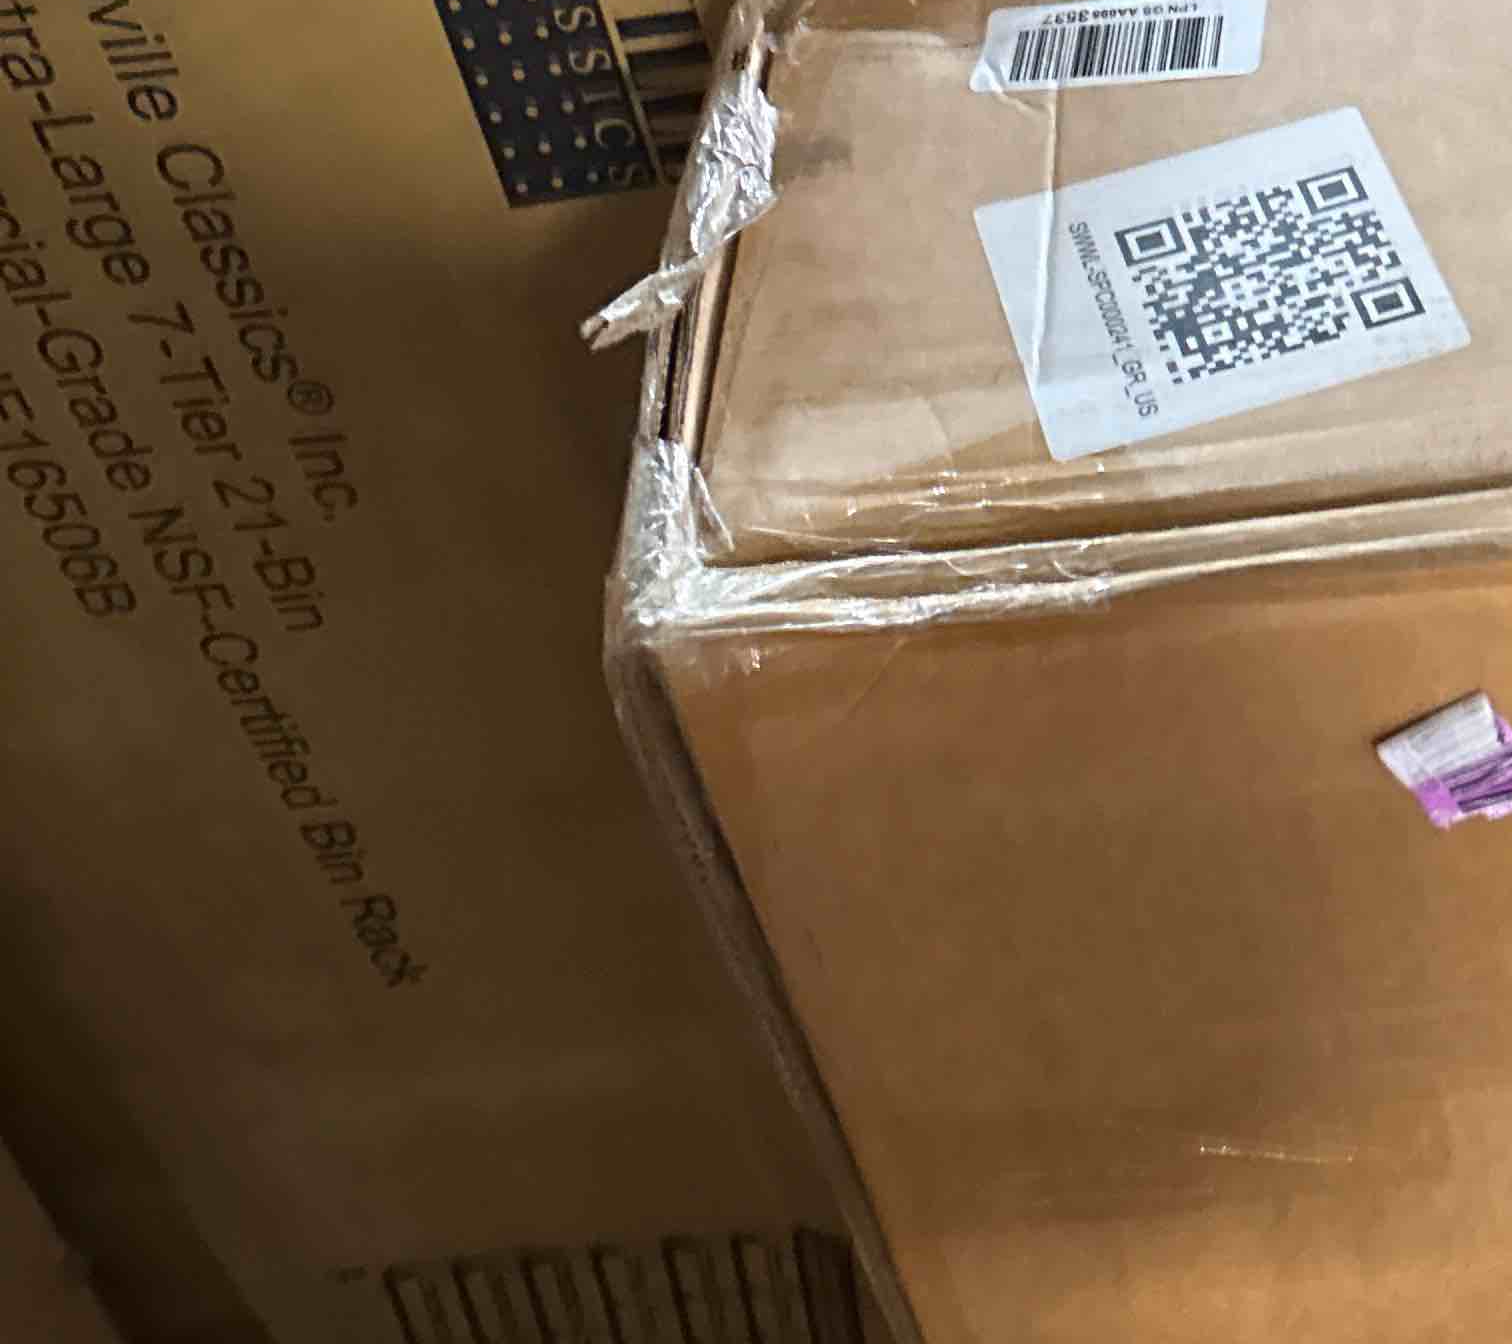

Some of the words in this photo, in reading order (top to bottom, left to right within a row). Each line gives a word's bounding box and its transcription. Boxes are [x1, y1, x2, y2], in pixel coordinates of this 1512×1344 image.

[127, 298, 243, 463] 7-Tier
[212, 474, 325, 638] 21-Bin
[288, 431, 358, 523] Inc.
[127, 505, 338, 812] NSF-Certified
[300, 818, 365, 888] Bin
[342, 893, 429, 989] Rack
